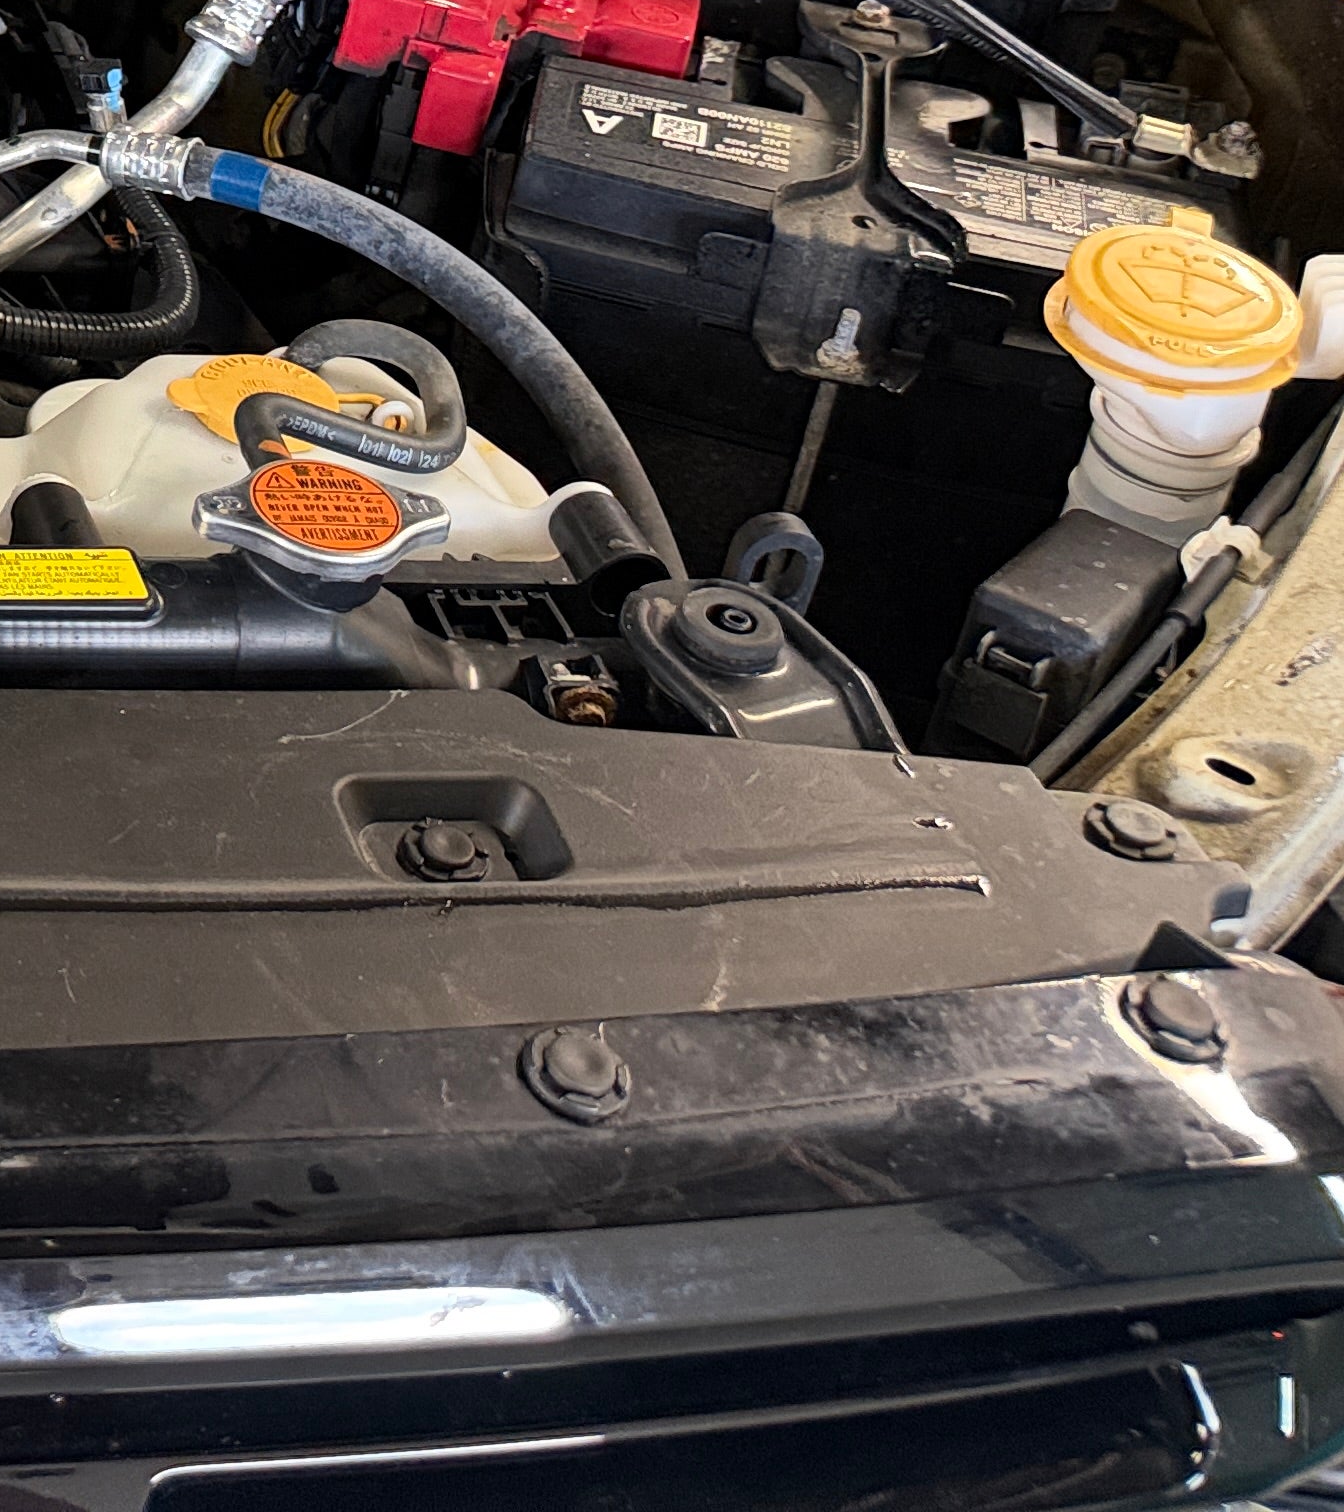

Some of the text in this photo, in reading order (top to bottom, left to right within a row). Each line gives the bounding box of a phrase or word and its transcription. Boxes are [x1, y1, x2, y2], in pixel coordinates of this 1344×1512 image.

[714, 143, 760, 158] AMPS
[296, 478, 363, 490] WARNING
[268, 504, 384, 514] NEVER OPEN WHEN HOT
[14, 552, 74, 561] ATTENTION
